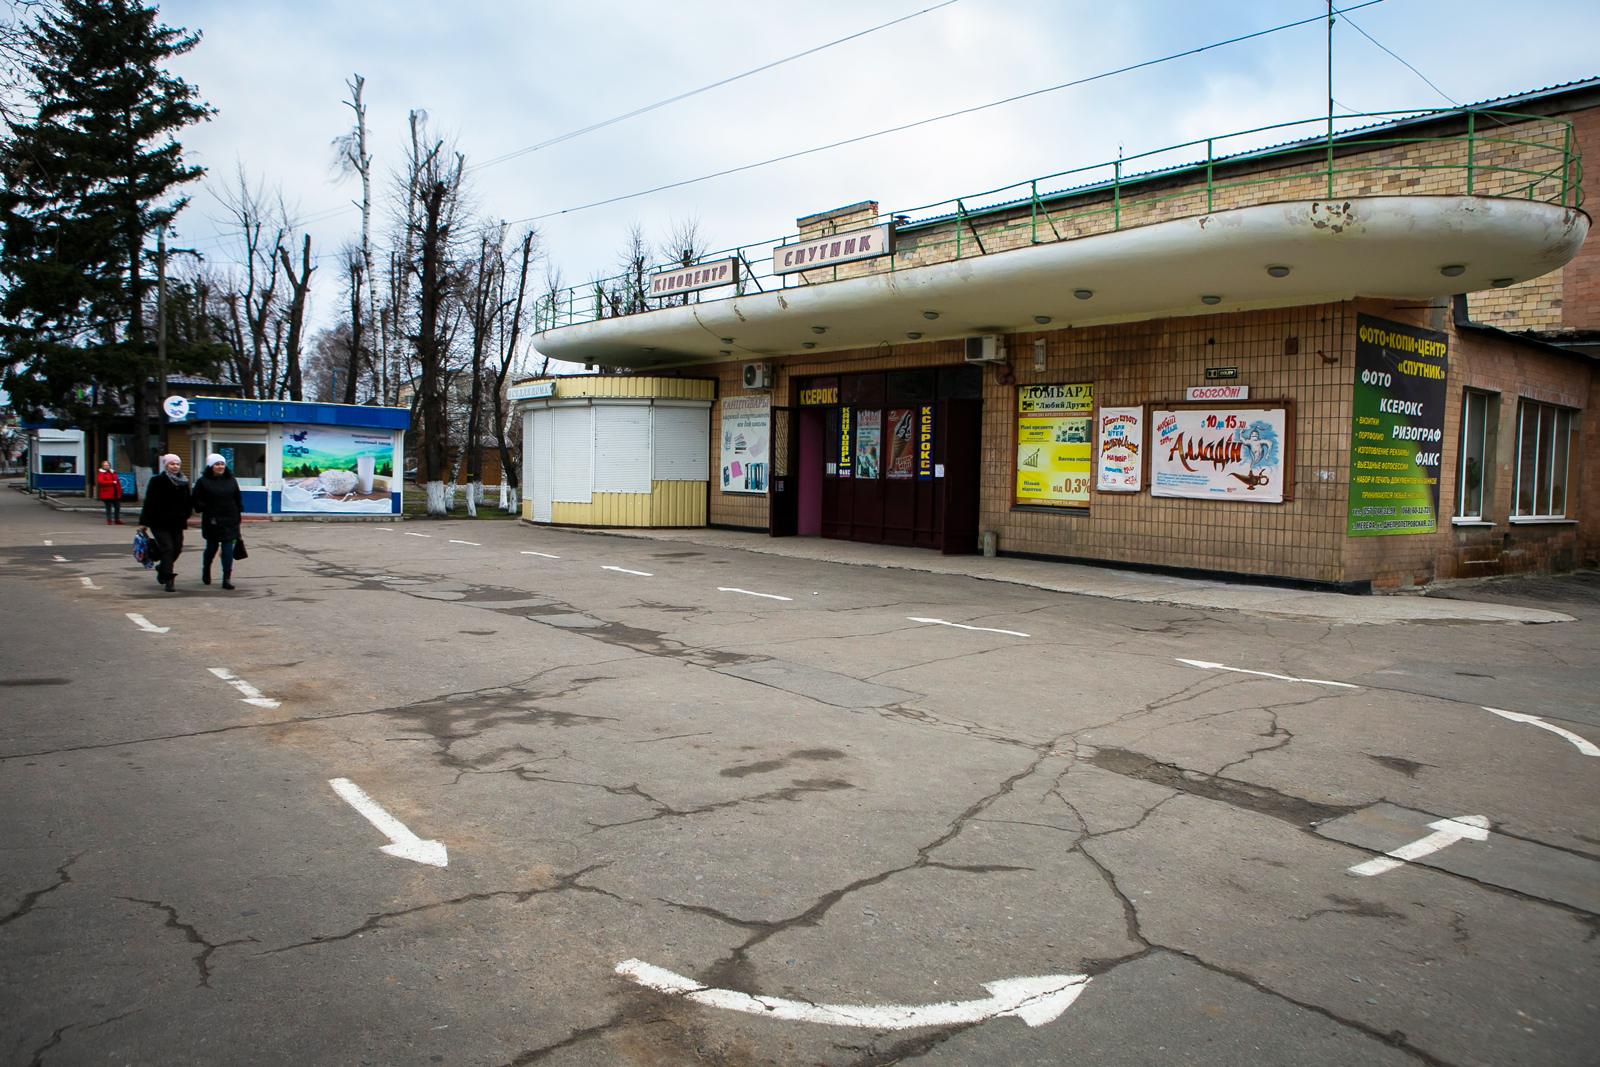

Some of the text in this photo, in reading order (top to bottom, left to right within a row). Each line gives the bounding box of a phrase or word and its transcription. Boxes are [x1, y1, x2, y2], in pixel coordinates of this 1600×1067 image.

[784, 234, 872, 267] СПУТНИК
[653, 265, 728, 293] КІНОЦЕНТР
[1397, 360, 1445, 380] «СПУТНИК»
[1361, 369, 1392, 388] ФОТО
[530, 386, 549, 397] ДОМА
[800, 387, 838, 405] КСЕРОКС
[1023, 386, 1093, 399] ЛОМБАРД
[722, 399, 770, 410] КАНЦТОВАРЫ
[1379, 398, 1424, 417] КСЕРОКС
[1206, 414, 1217, 428] 10
[1225, 415, 1237, 429] 15
[1358, 417, 1379, 426] ВИЗИТКИ
[841, 407, 850, 463] КАНЦТОВАРЫ
[920, 406, 932, 469] КСЕРОКС
[1358, 431, 1384, 441] ПОРТФОЛИО
[1392, 425, 1441, 442] РИЗОГРАФ
[1358, 446, 1410, 457] ИЗГОТОВЛЕНИЕ РЕКЛАМЫ
[1415, 451, 1440, 466] ФАКС
[1357, 460, 1409, 470] ВЫЕЗДНЫЕ ФОТОСЕССИИ
[1356, 476, 1371, 484] НАБОР
[1375, 476, 1390, 484] ПЕЧАТЬ
[1052, 484, 1063, 493] від
